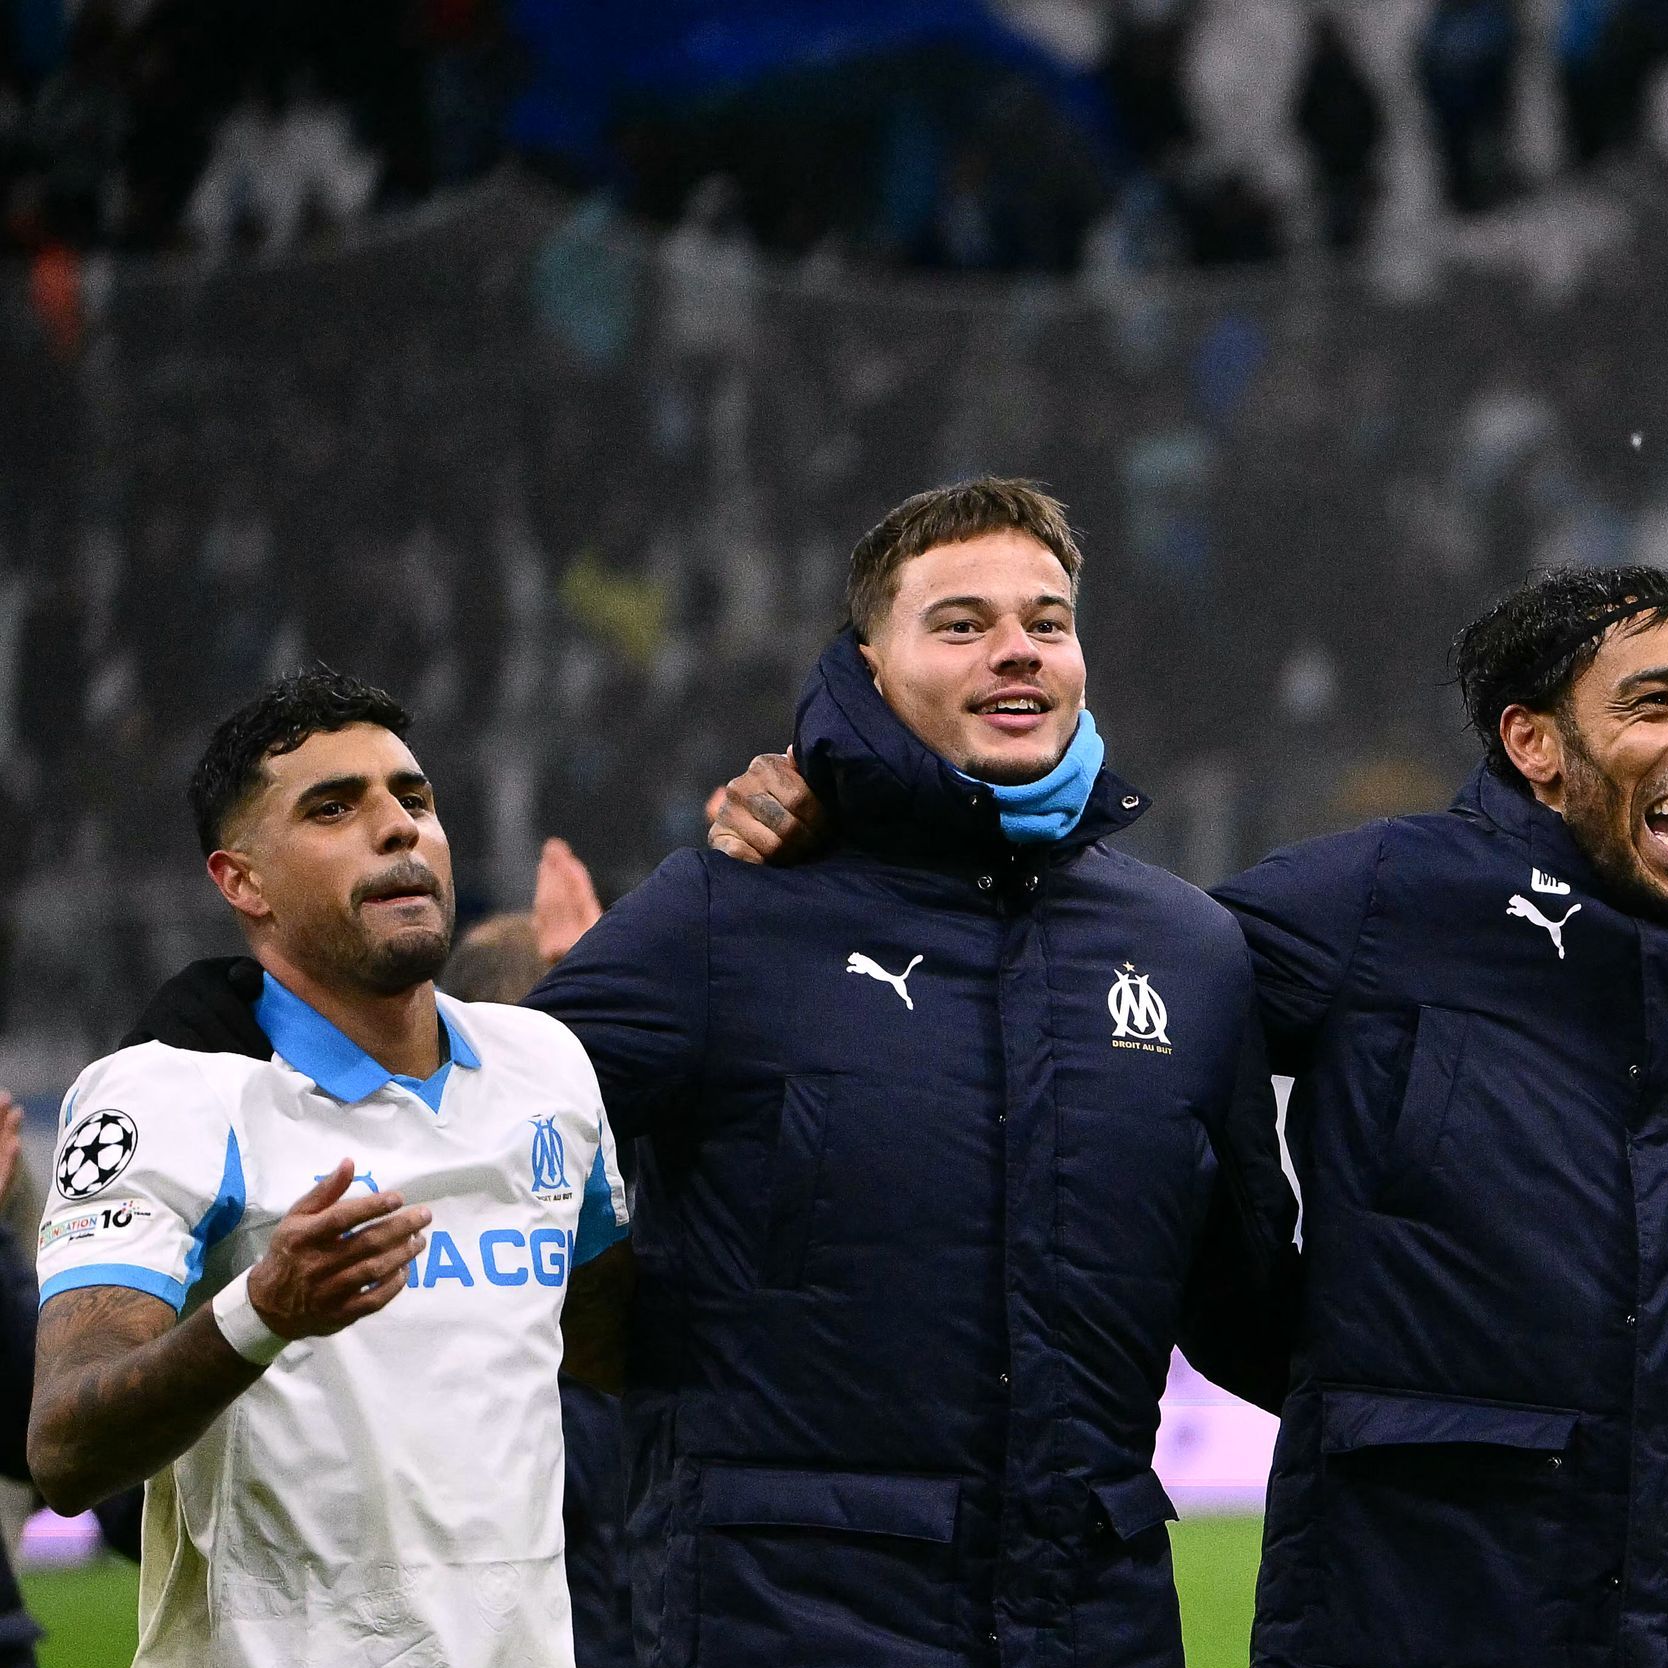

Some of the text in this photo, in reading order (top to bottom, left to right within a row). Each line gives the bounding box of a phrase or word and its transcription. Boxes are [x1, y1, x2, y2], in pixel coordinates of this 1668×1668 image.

[1112, 1040, 1173, 1055] DROIT AU BUT
[101, 1209, 133, 1229] 10
